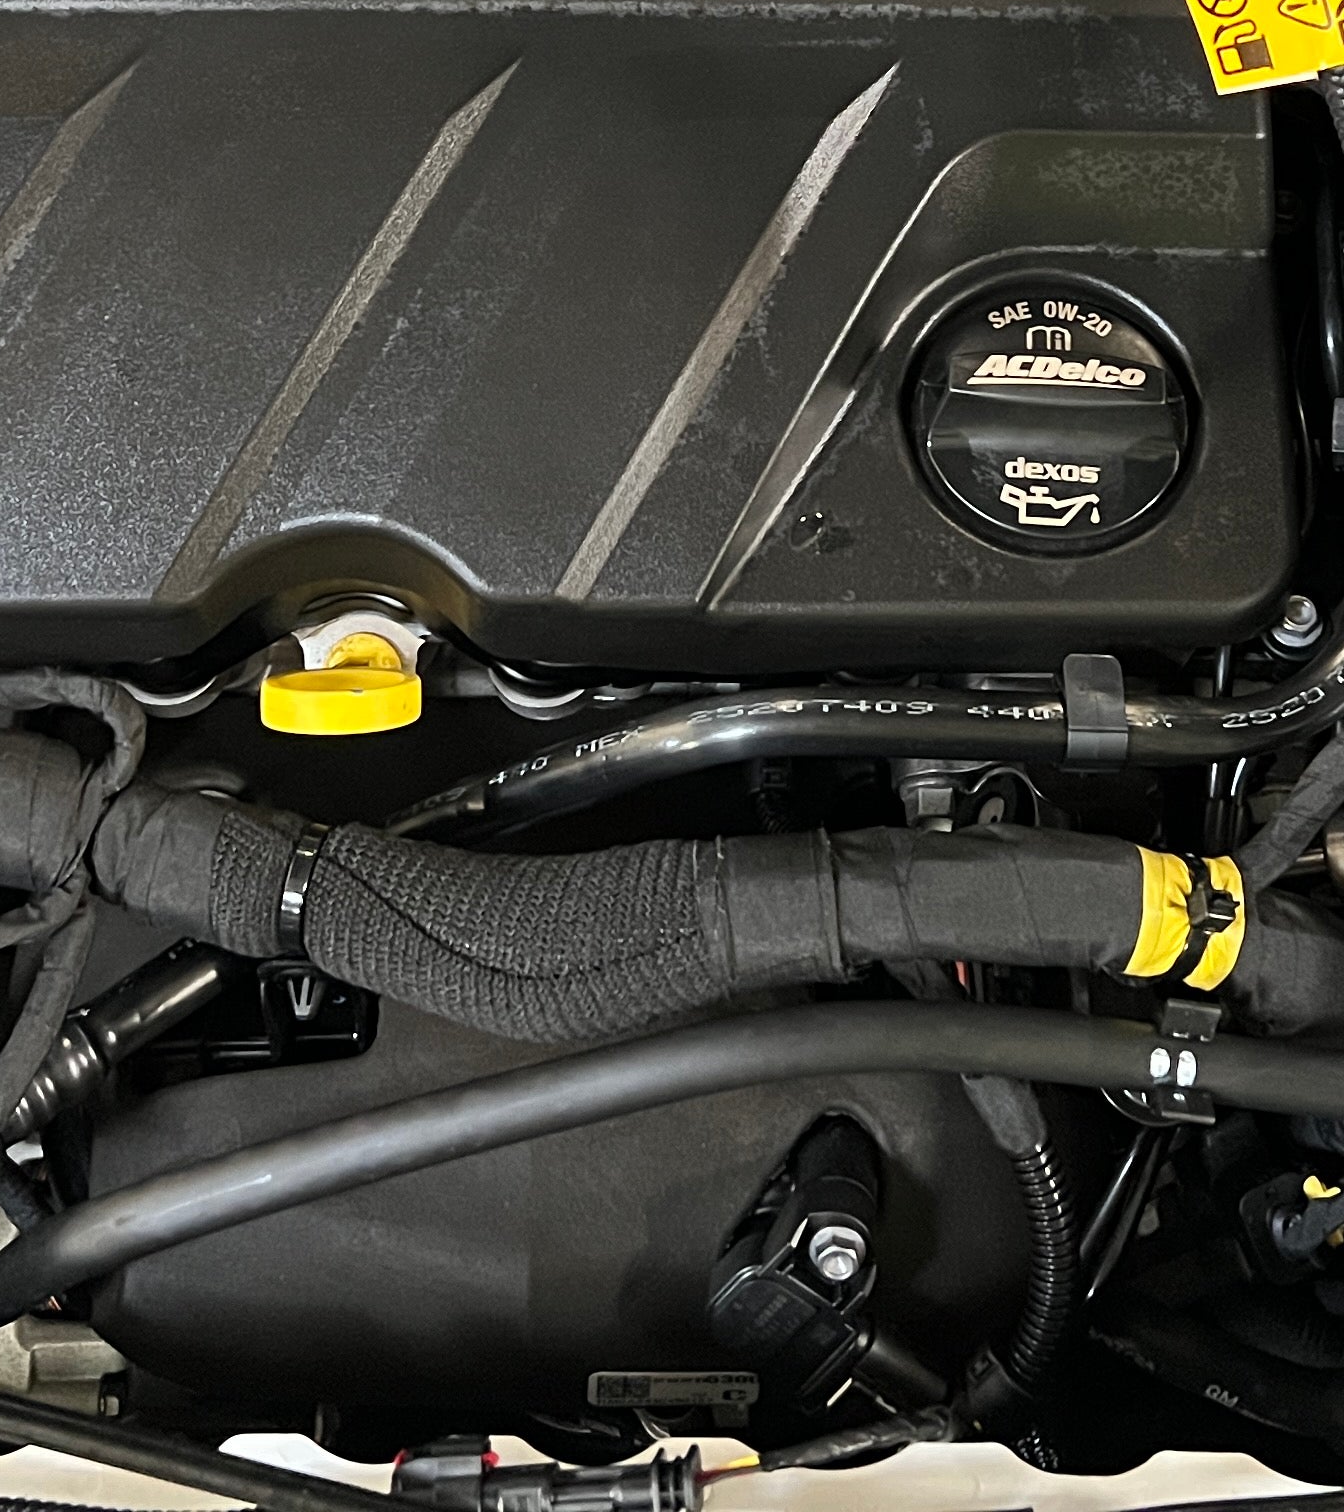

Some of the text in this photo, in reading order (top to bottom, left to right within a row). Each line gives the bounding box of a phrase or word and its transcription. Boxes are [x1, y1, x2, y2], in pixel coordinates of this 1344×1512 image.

[987, 300, 1113, 338] SAE 0W-20
[973, 354, 1147, 386] ACDelco
[1004, 456, 1102, 484] dexos
[575, 724, 644, 758] MEX
